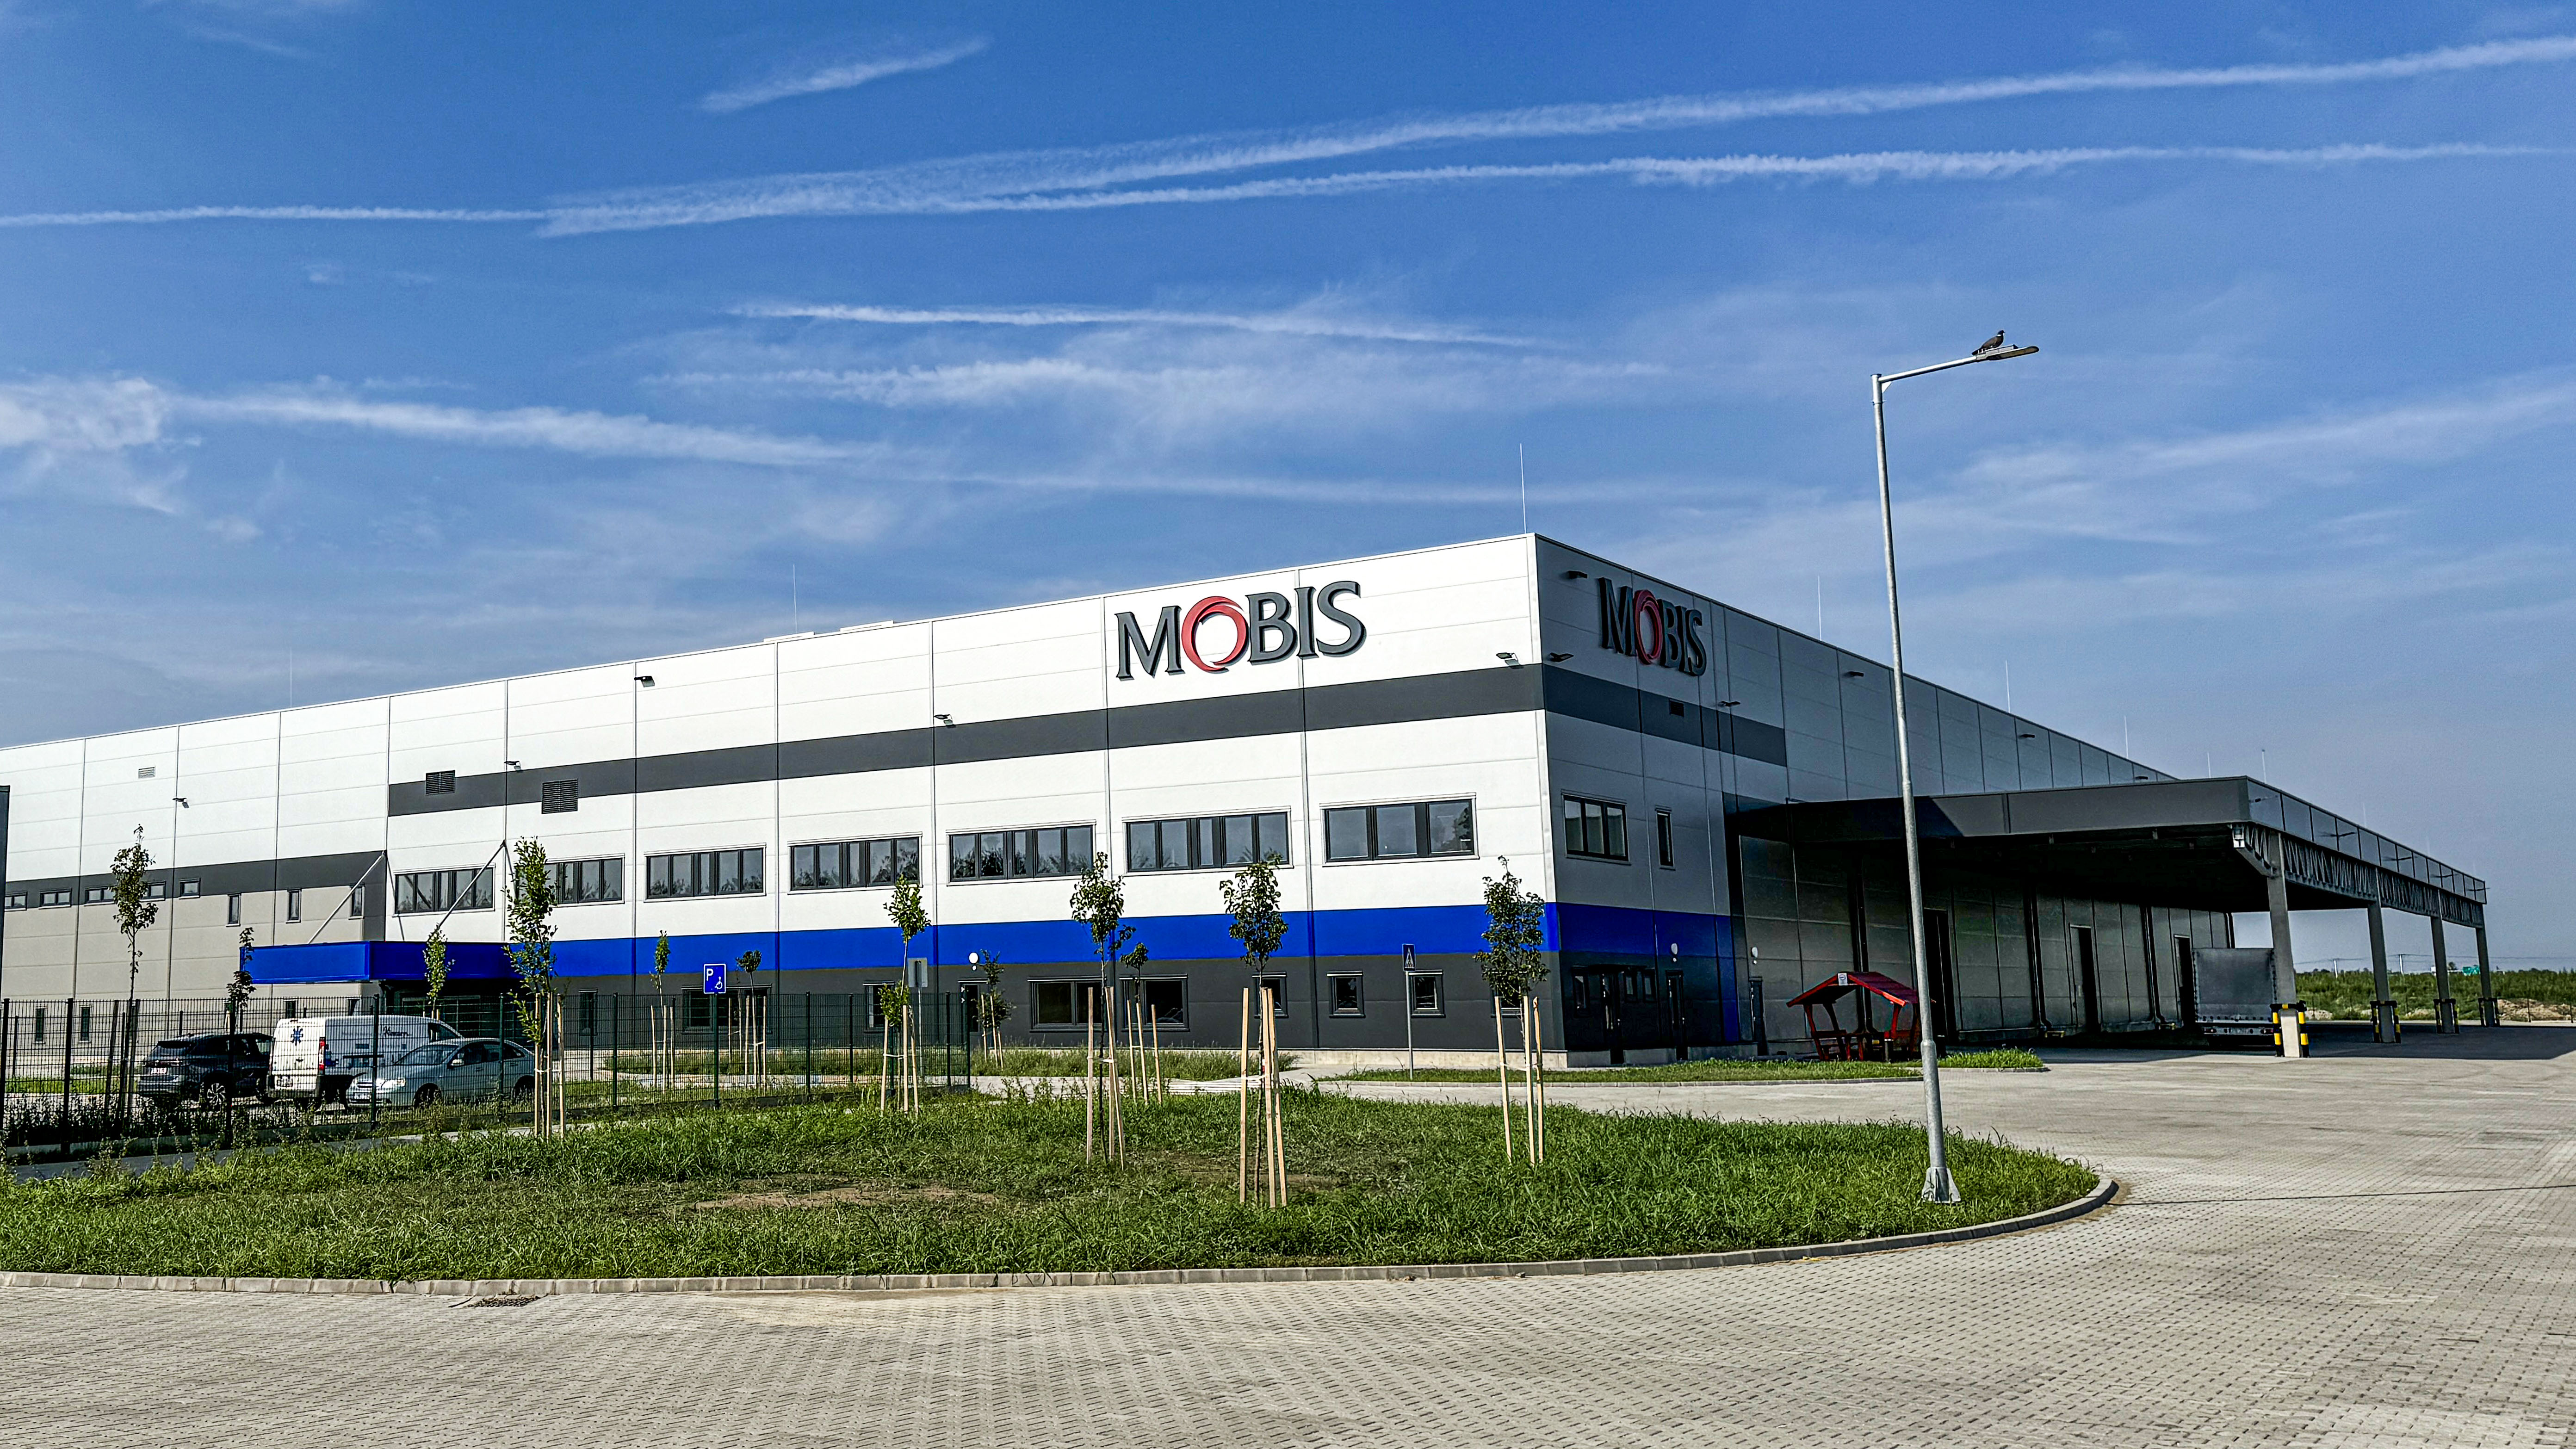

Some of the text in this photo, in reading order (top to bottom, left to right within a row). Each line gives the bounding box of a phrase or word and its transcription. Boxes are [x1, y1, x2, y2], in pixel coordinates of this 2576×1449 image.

[1115, 581, 1367, 681] MOBIS
[1598, 577, 1707, 676] MOBIS
[706, 968, 713, 981] P
